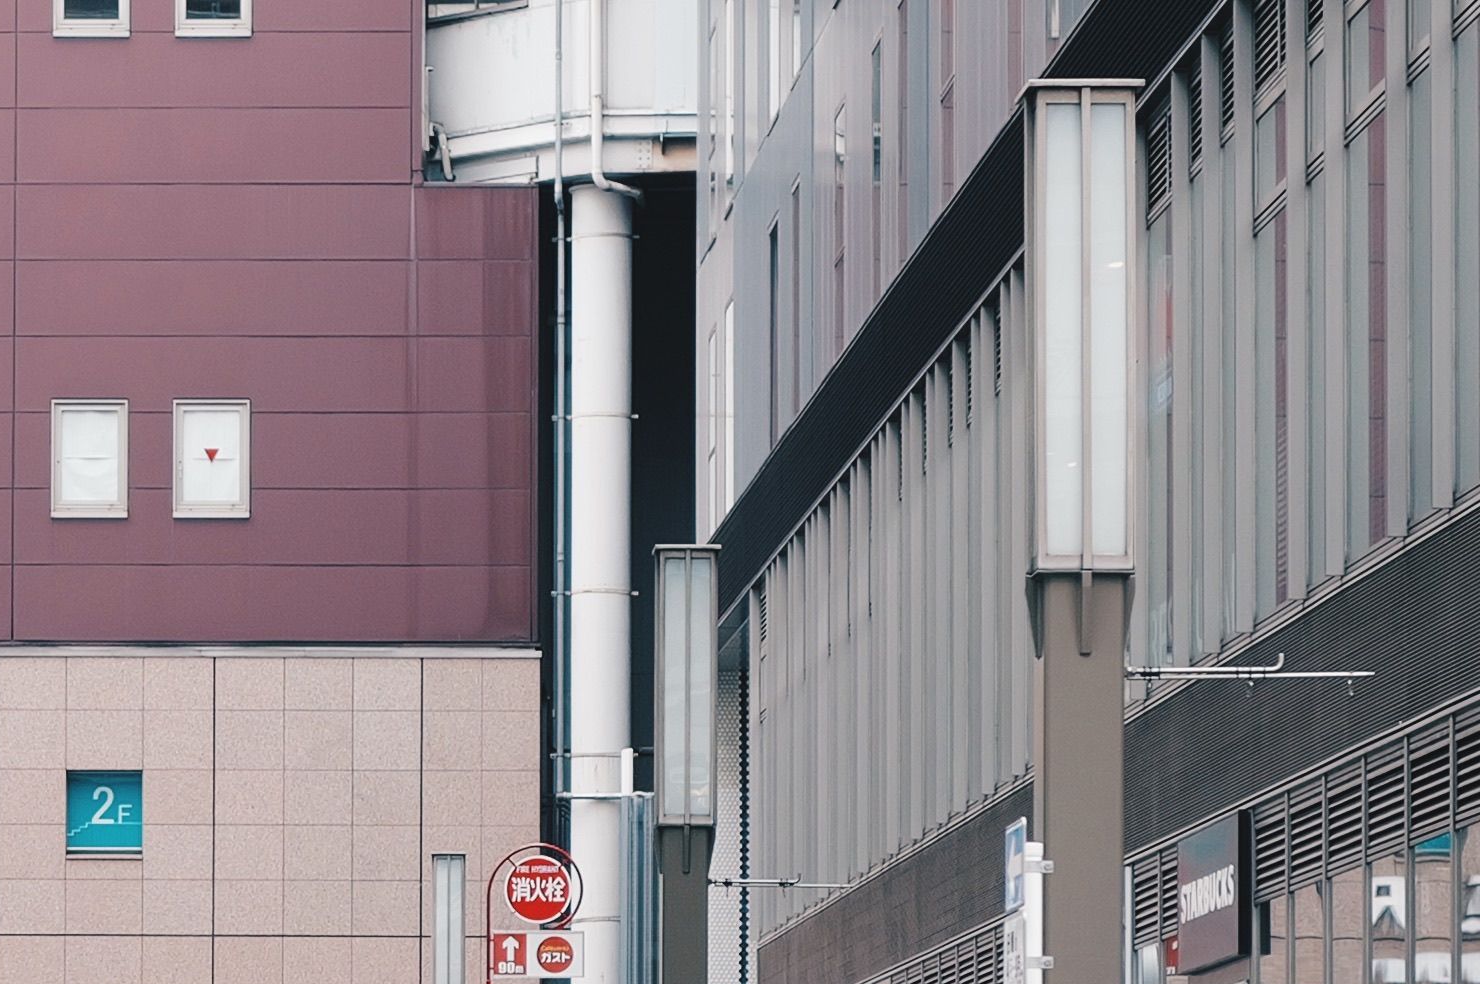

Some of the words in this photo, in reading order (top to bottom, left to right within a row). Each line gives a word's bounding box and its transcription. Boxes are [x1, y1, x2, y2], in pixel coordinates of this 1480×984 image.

[91, 786, 133, 825] 2F
[511, 877, 566, 902] 消火栓
[1181, 864, 1235, 923] STARBUCKS
[541, 951, 571, 964] ガスト
